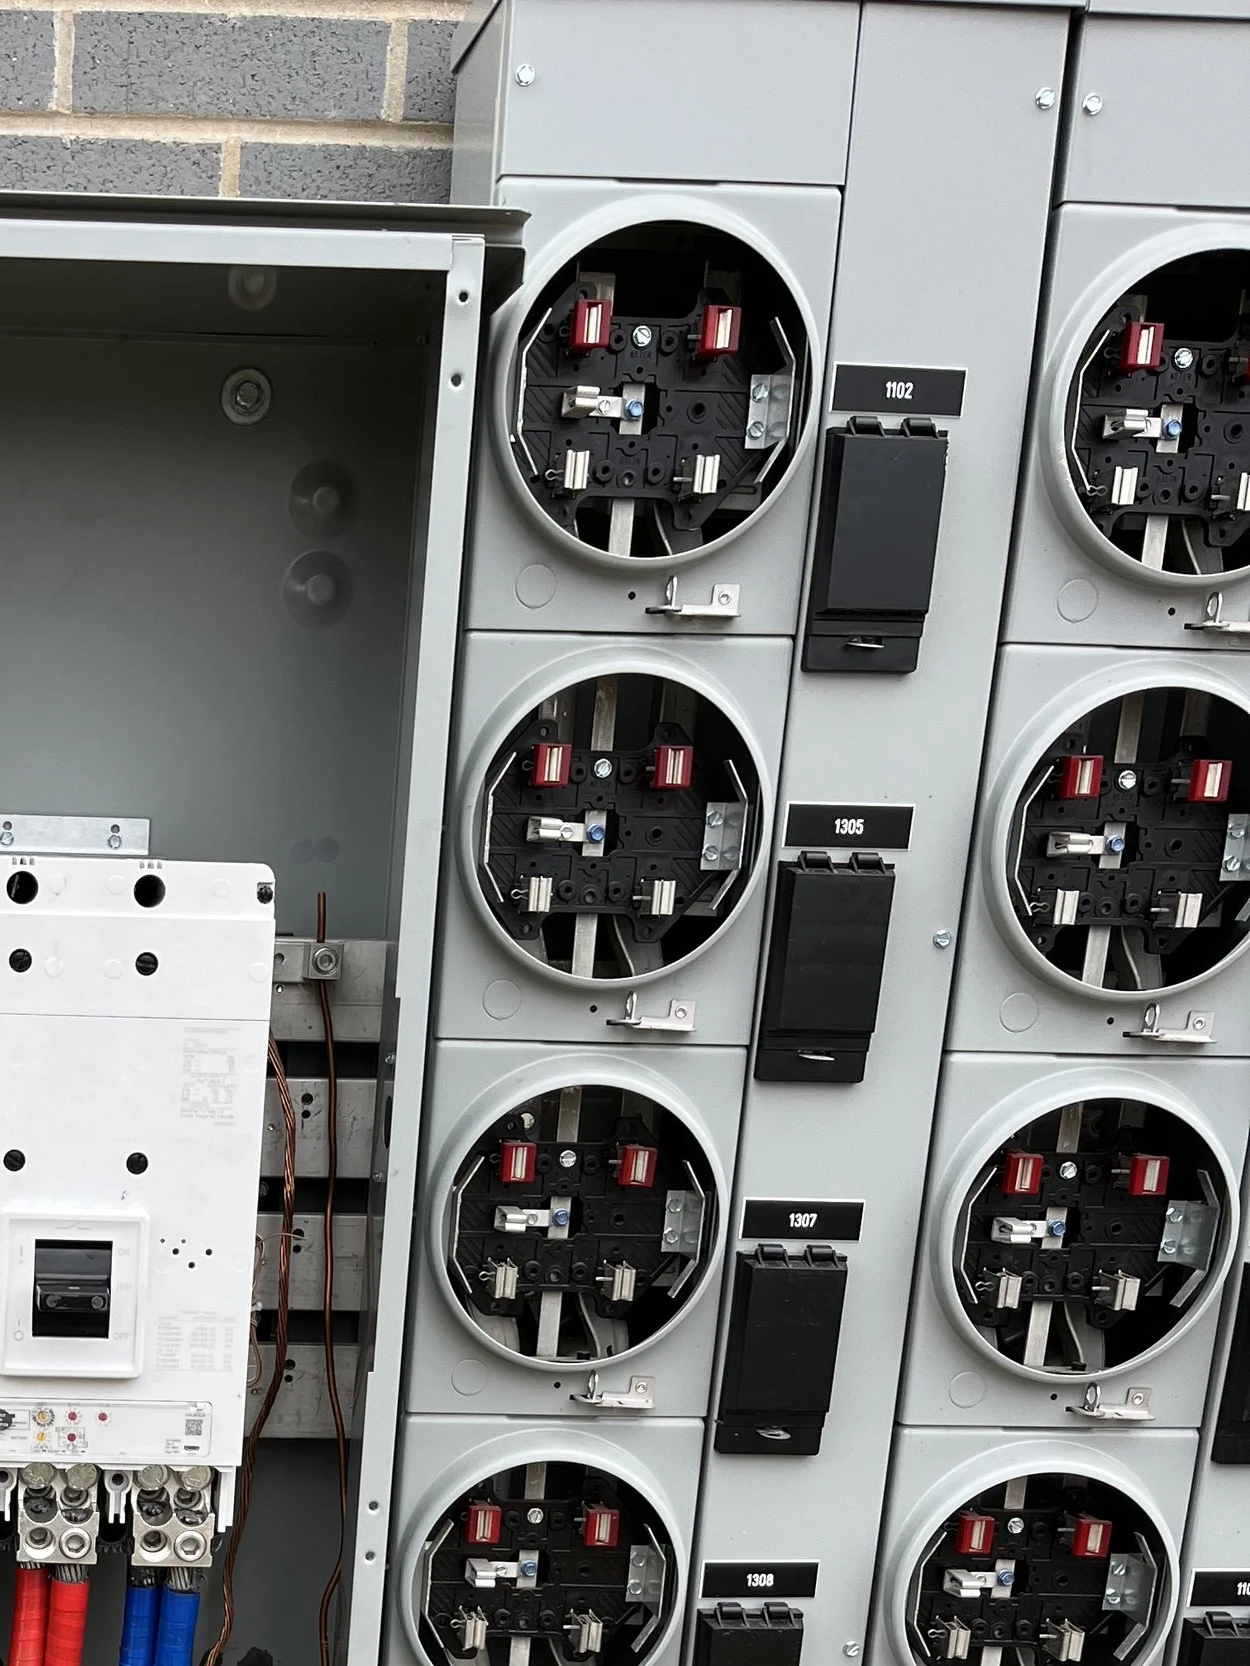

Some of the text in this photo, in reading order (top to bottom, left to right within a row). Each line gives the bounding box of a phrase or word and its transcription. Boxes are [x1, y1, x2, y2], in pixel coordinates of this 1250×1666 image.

[885, 380, 914, 400] 1102
[834, 818, 864, 835] 1305
[789, 1212, 818, 1228] 1307
[117, 1248, 130, 1257] ON
[113, 1333, 130, 1341] OFF
[746, 1573, 775, 1588] 1308
